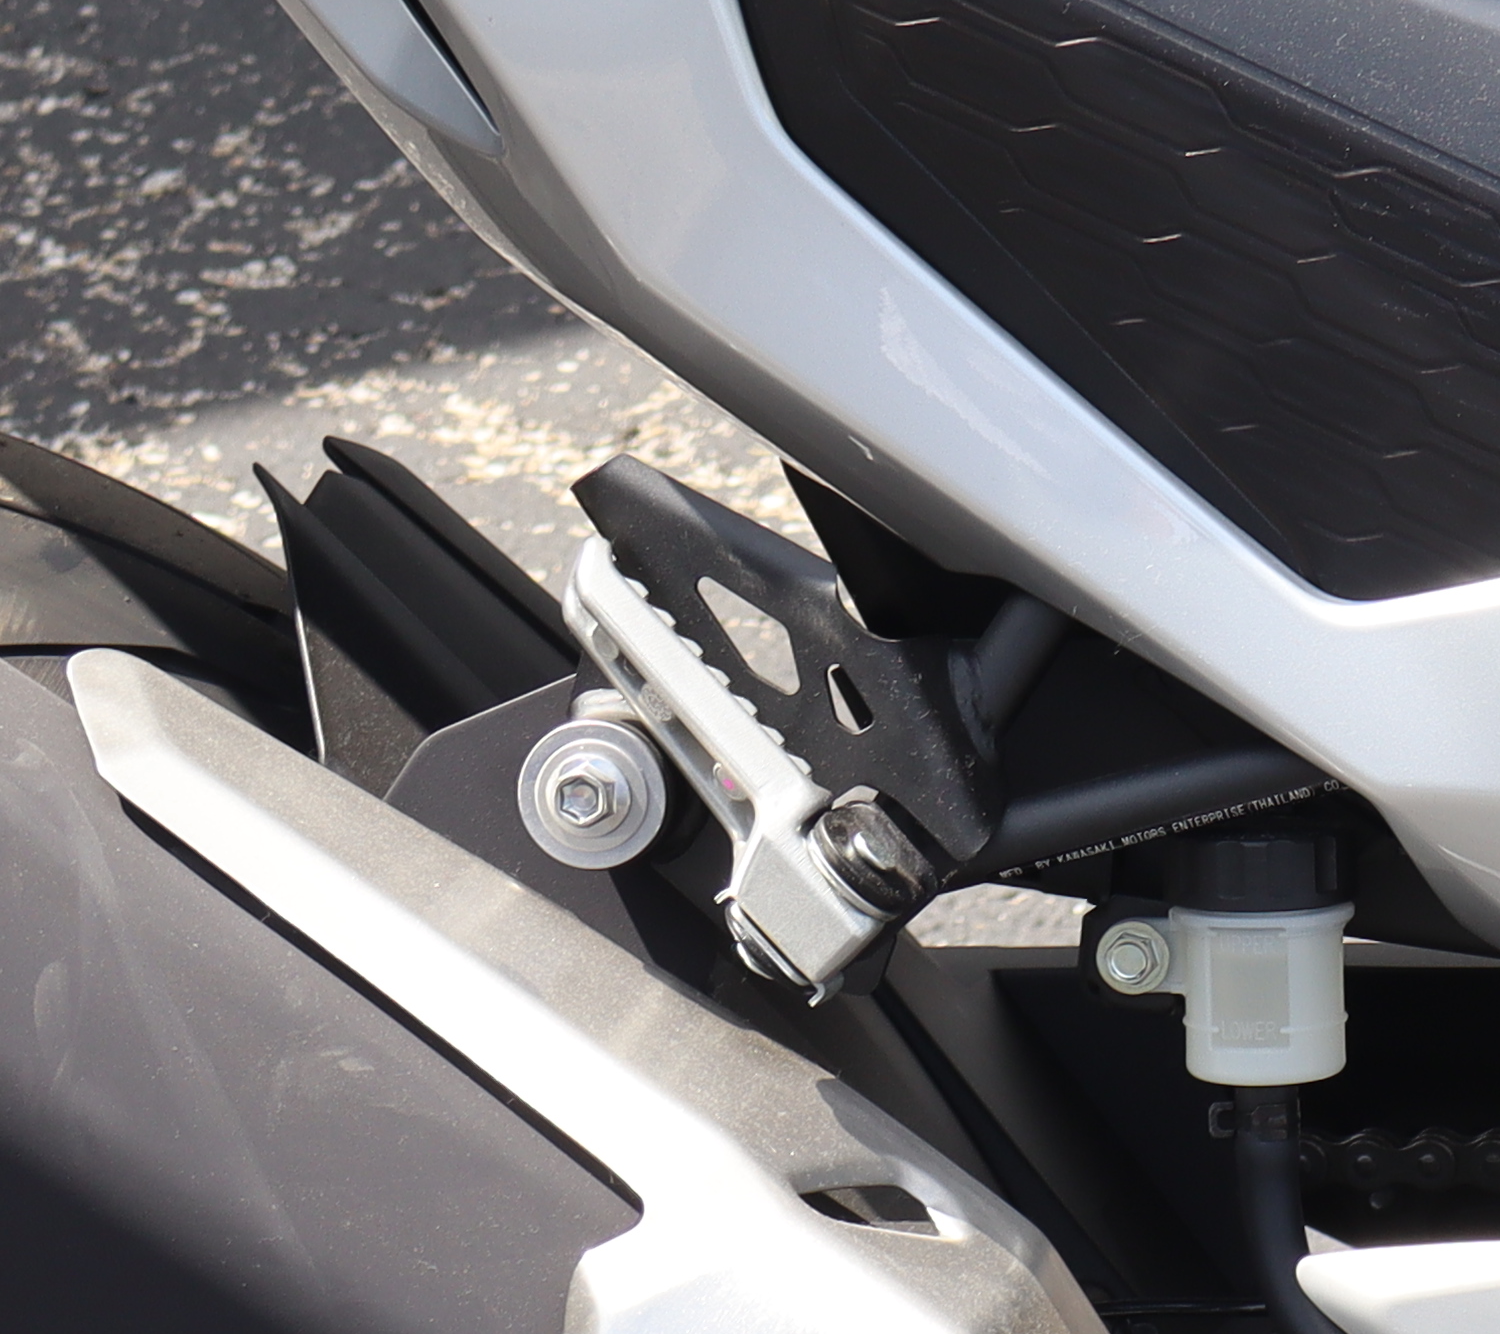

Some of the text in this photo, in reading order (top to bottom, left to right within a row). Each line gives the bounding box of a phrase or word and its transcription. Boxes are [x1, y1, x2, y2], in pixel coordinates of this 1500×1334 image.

[1056, 840, 1116, 864] KAWASAKI
[1120, 826, 1168, 847] MOTORS
[1221, 1020, 1277, 1041] LOWER
